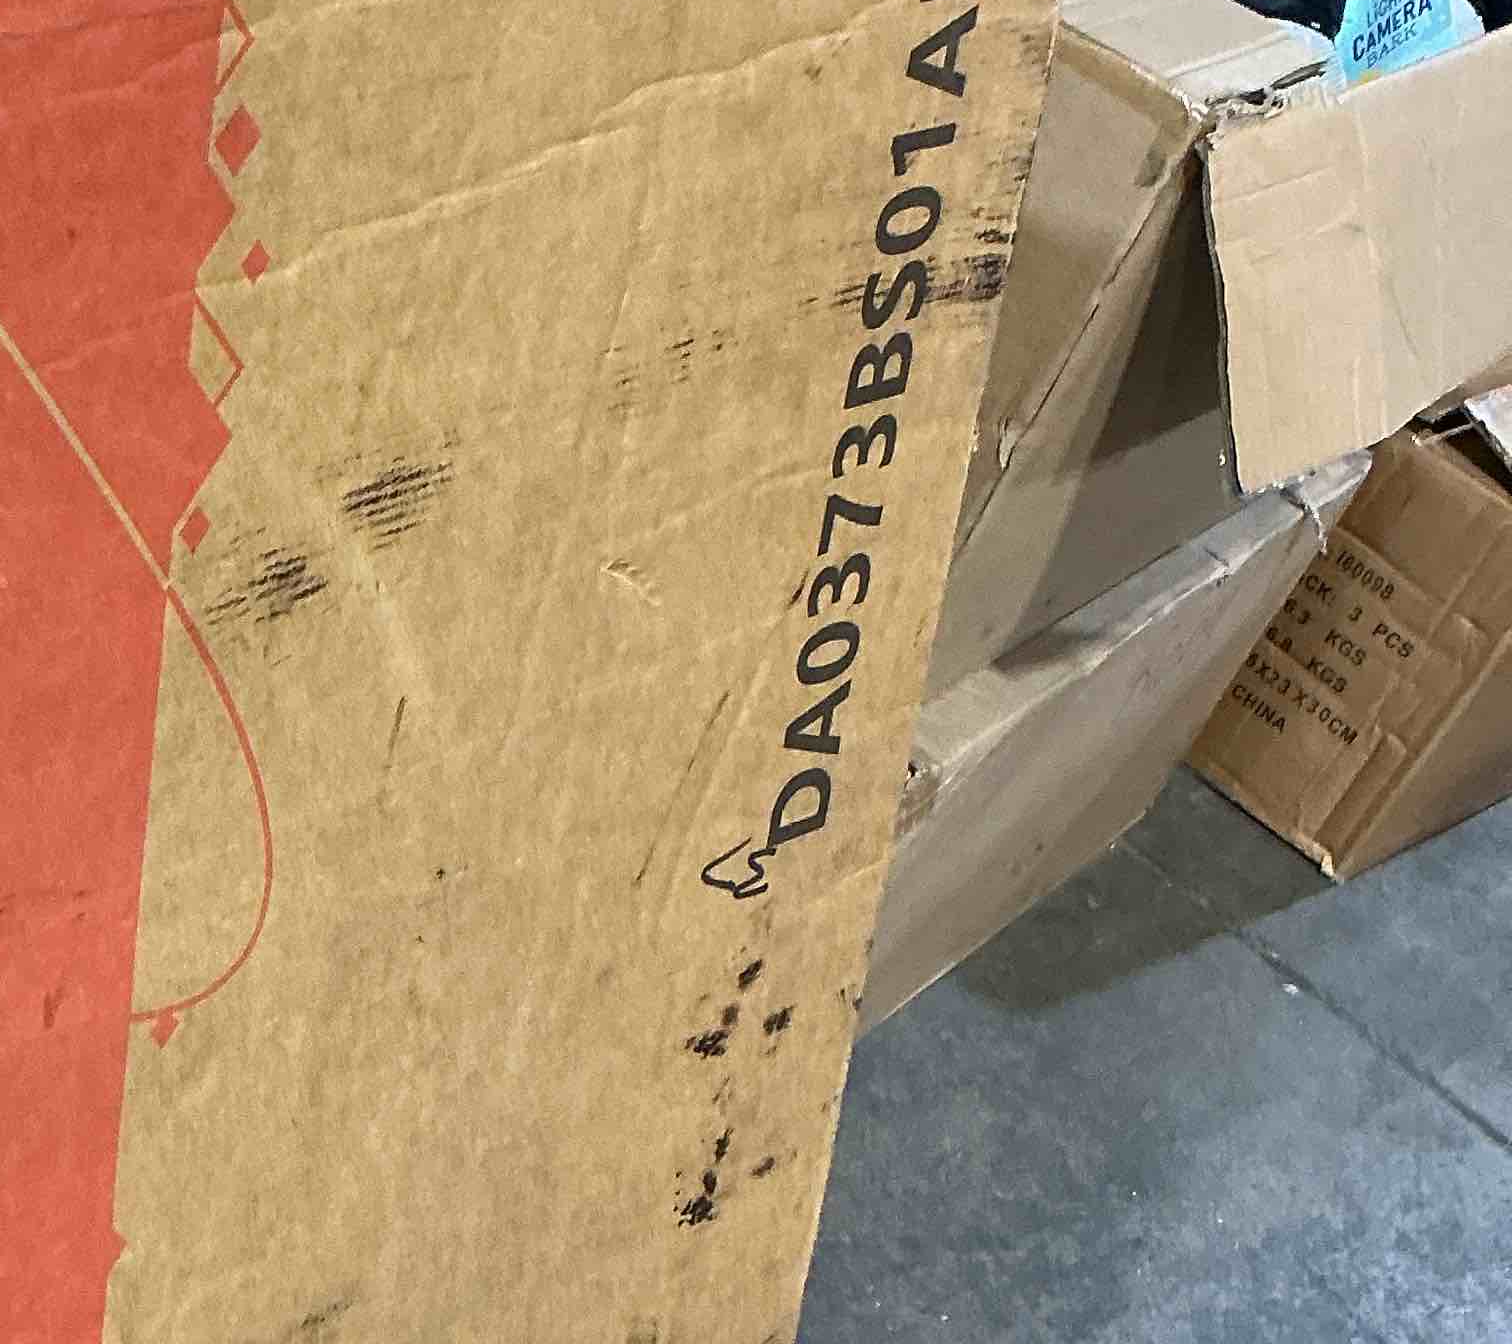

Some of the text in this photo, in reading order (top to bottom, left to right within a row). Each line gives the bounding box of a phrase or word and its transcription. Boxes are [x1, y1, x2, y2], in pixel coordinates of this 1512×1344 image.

[1364, 23, 1420, 69] BARK
[1323, 628, 1367, 667] KGS
[1347, 606, 1364, 623] 3
[1372, 623, 1415, 659] PCS
[1231, 683, 1288, 734] CHINA
